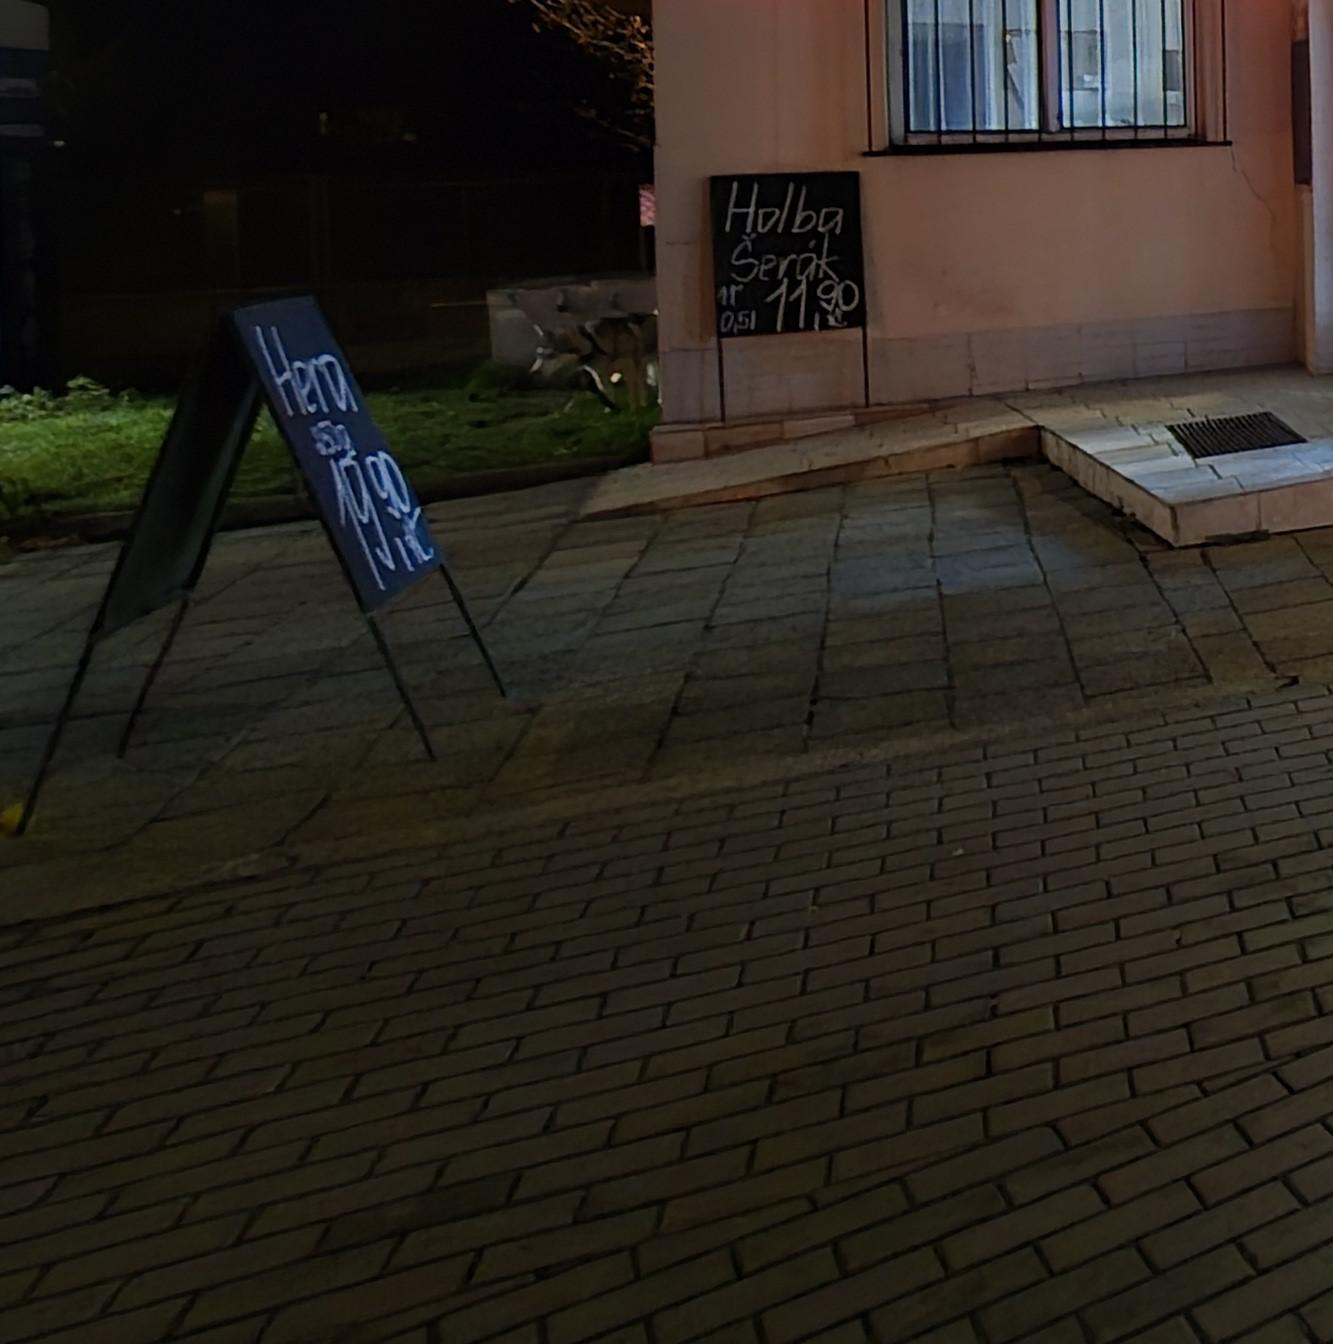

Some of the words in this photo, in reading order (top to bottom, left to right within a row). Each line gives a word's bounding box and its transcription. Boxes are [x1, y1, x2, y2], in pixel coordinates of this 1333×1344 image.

[725, 181, 844, 234] Holba
[730, 232, 841, 282] Šerák
[254, 325, 359, 416] Hera
